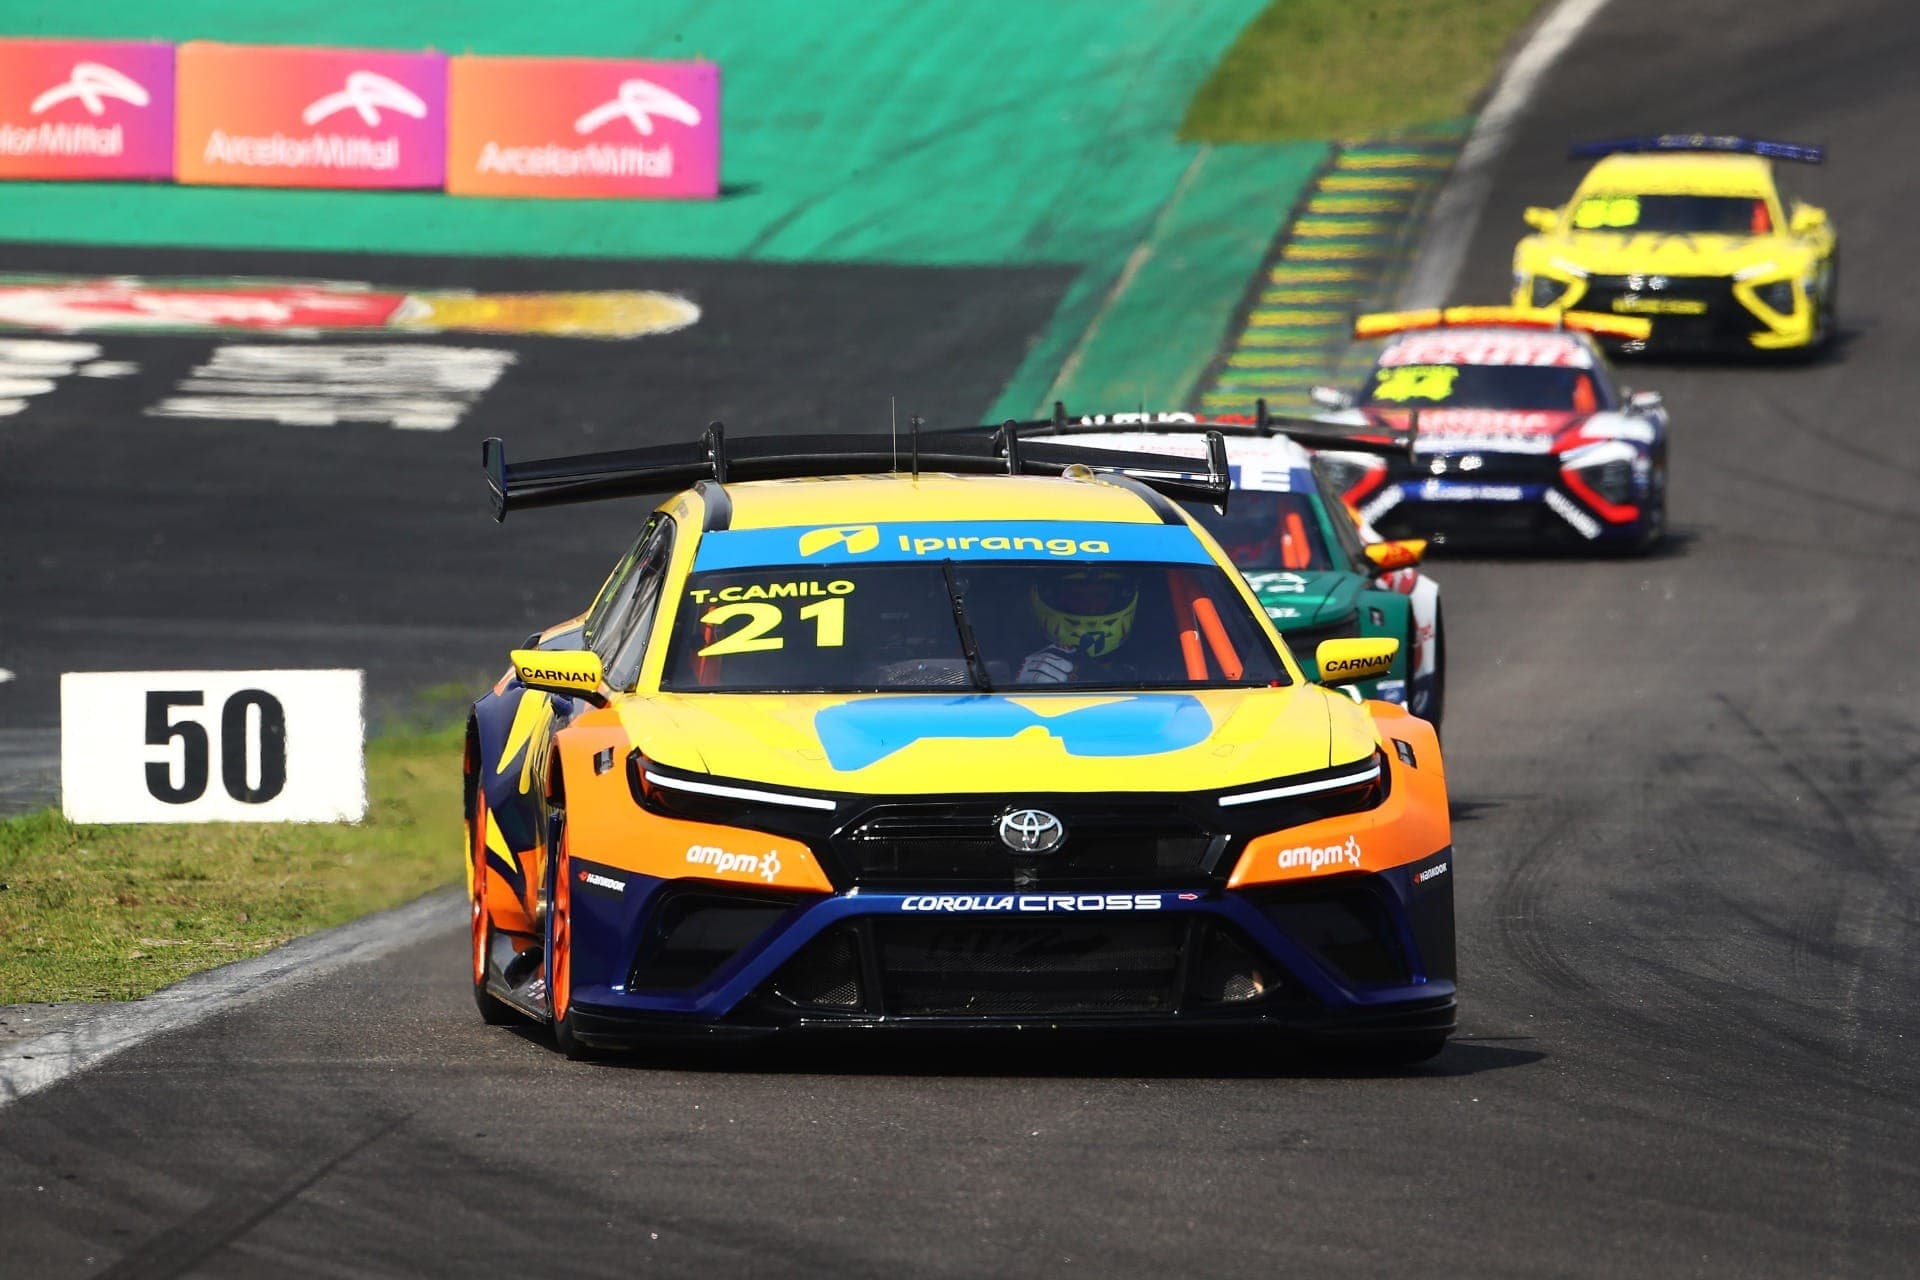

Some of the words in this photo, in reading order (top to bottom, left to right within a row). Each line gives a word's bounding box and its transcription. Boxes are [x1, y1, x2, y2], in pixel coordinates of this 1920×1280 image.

[205, 130, 399, 169] ArcelorMittal
[477, 142, 673, 177] ArcelorMittal
[898, 535, 1110, 556] Ipiranga
[690, 580, 855, 604] T.CAMILO
[697, 597, 845, 657] 21
[521, 667, 596, 682] CARNAN
[1325, 653, 1394, 672] CARNAN
[144, 688, 287, 805] 50
[686, 844, 759, 874] ampm
[1278, 845, 1343, 872] ampm
[901, 895, 1015, 912] COROLLA
[1018, 894, 1162, 911] CROSS
